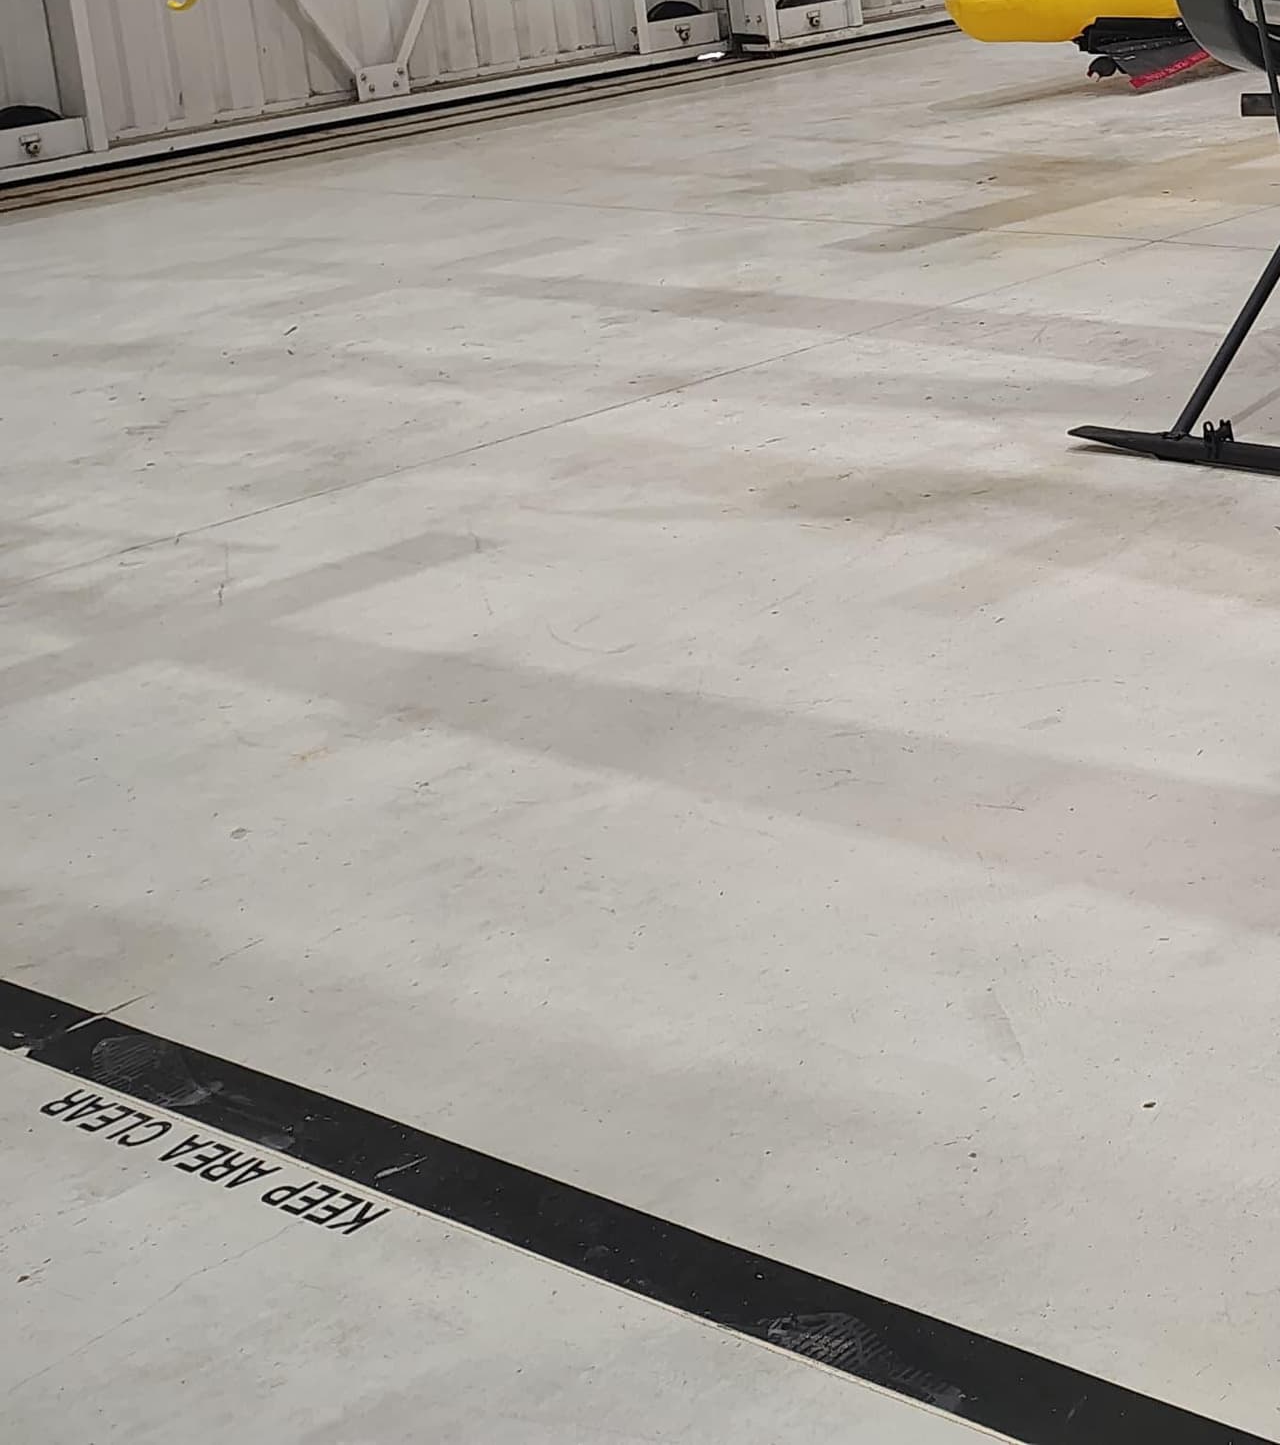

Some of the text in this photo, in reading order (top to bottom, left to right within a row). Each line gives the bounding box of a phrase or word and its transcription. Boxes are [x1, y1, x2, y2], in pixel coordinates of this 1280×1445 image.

[39, 1088, 391, 1235] KEEP AREA CLEAR
